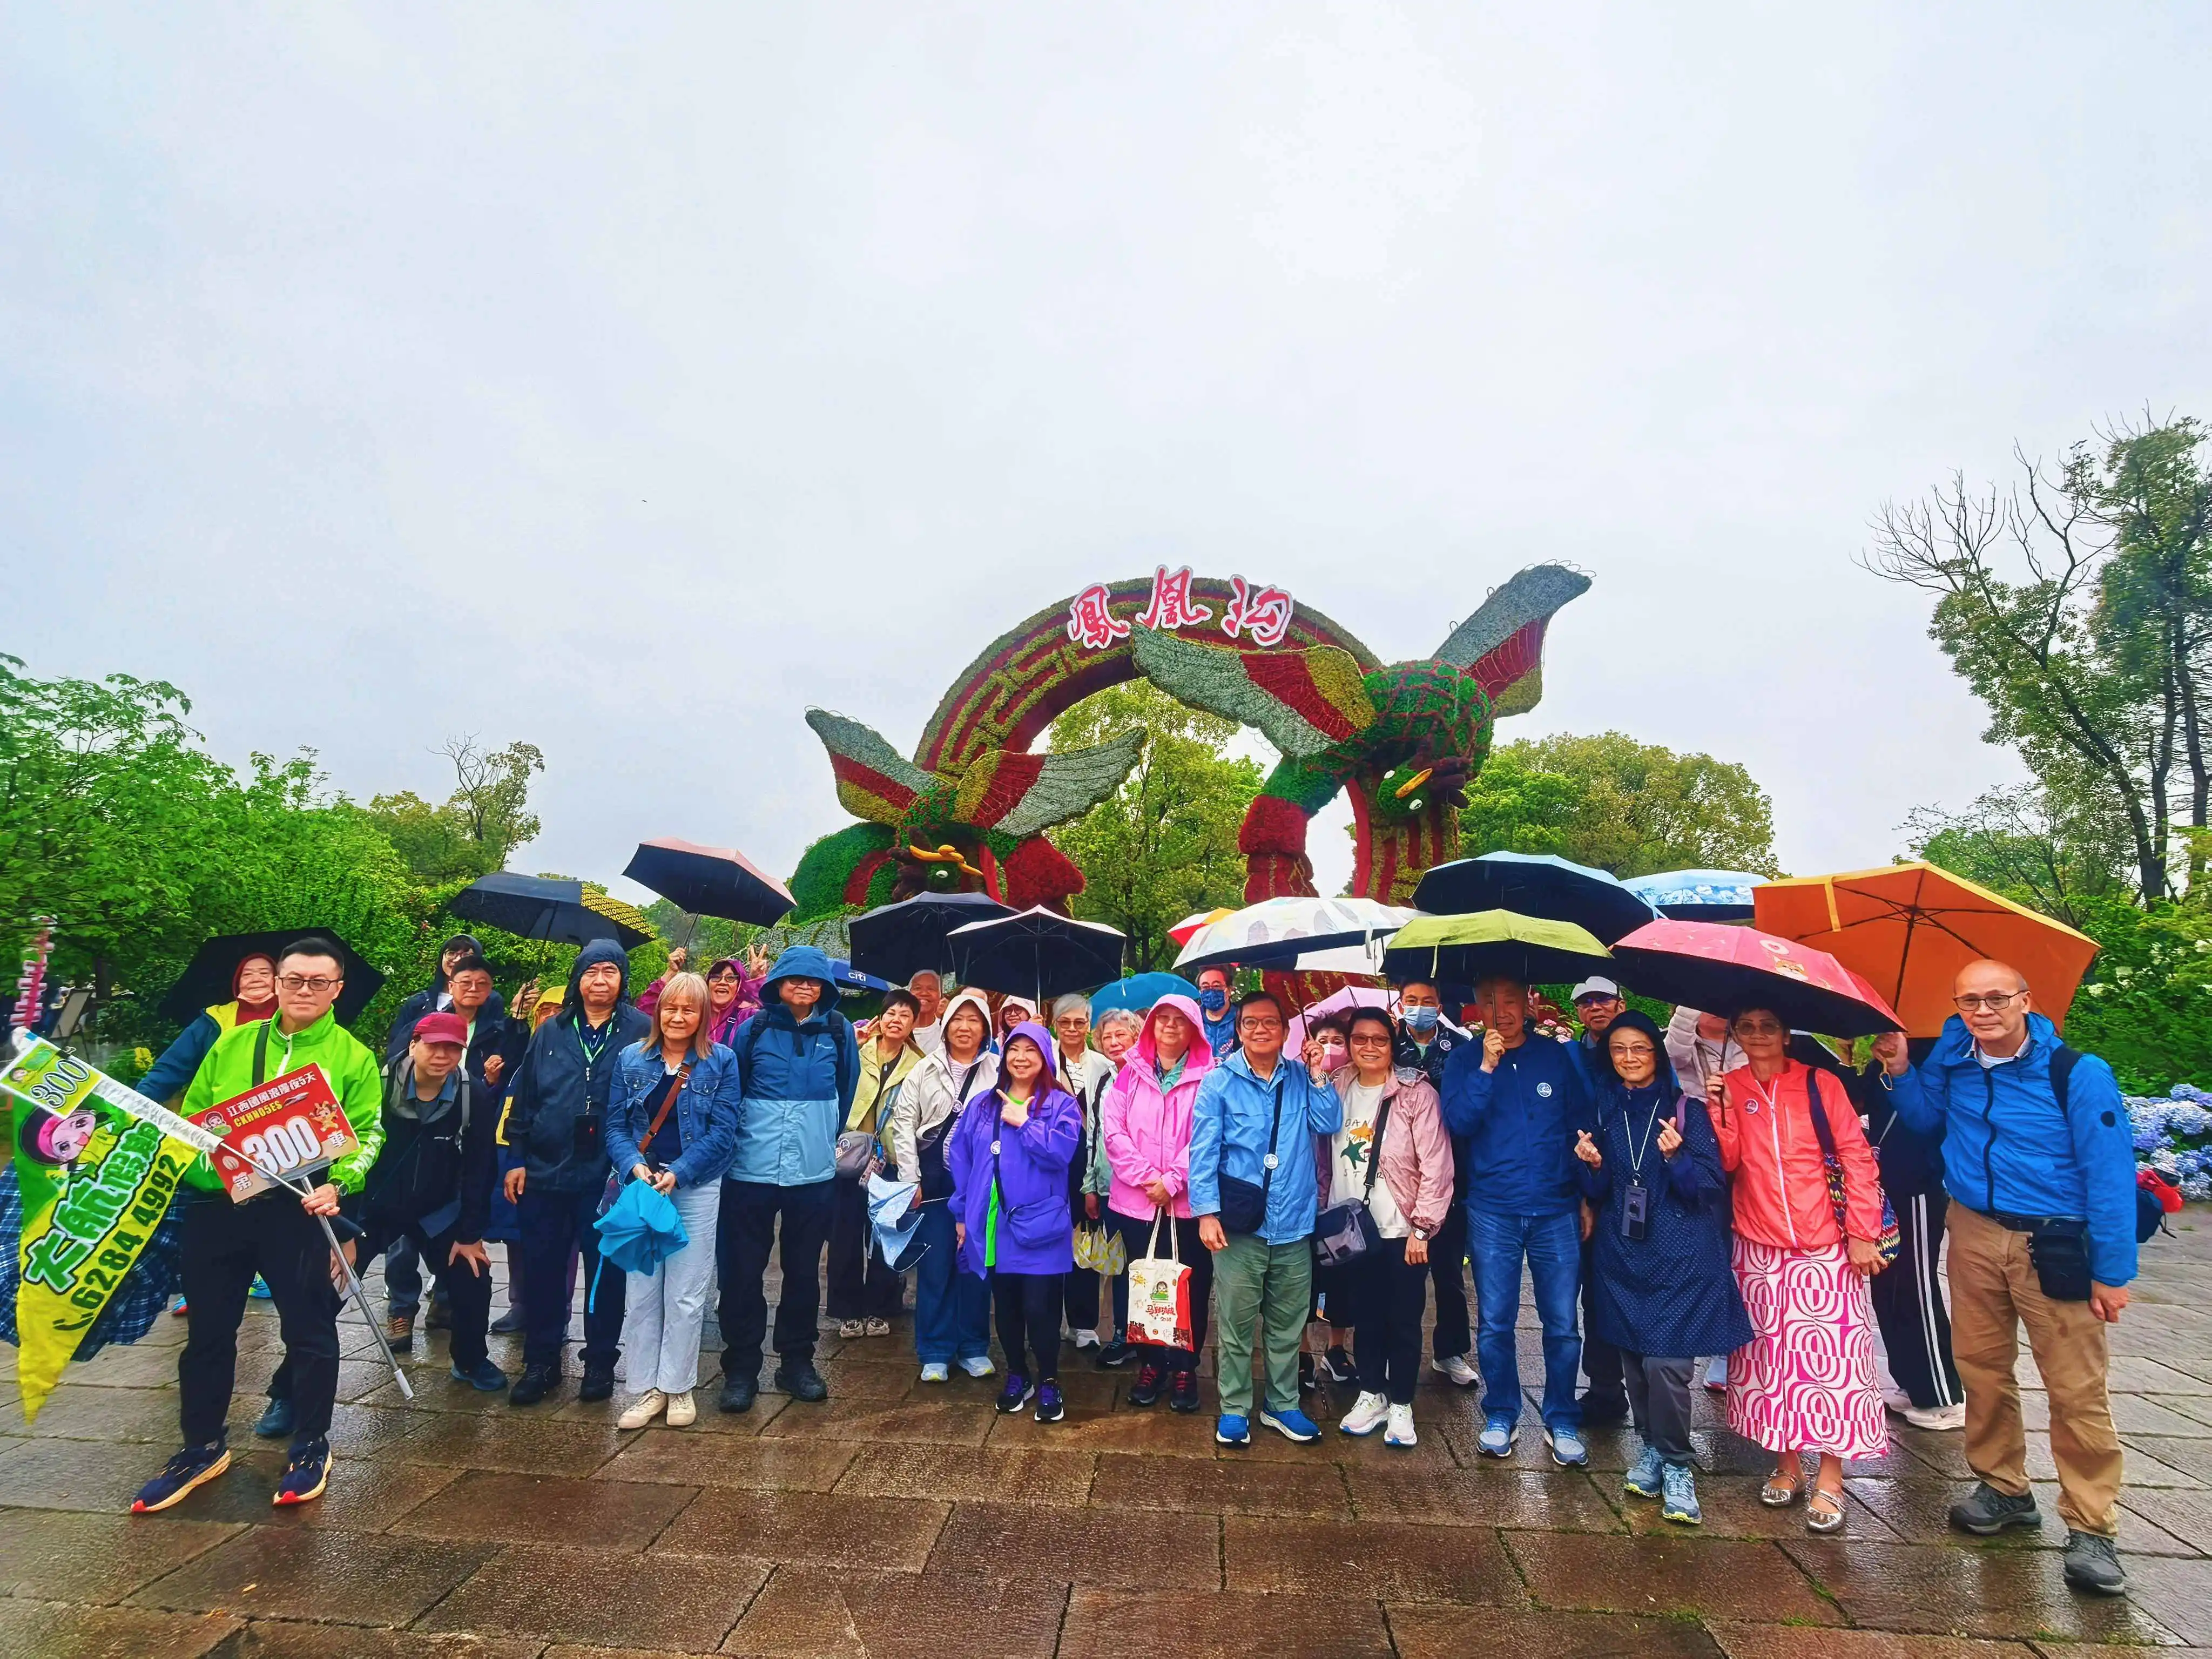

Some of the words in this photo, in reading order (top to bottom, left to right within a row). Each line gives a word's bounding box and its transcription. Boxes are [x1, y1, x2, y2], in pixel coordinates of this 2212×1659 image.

[848, 972, 866, 982] citi
[30, 1057, 90, 1109] 300
[241, 1115, 322, 1179] 300
[327, 1129, 348, 1149] 車
[232, 1171, 253, 1191] 第
[71, 1230, 143, 1309] 6284
[131, 1154, 187, 1225] 4992
